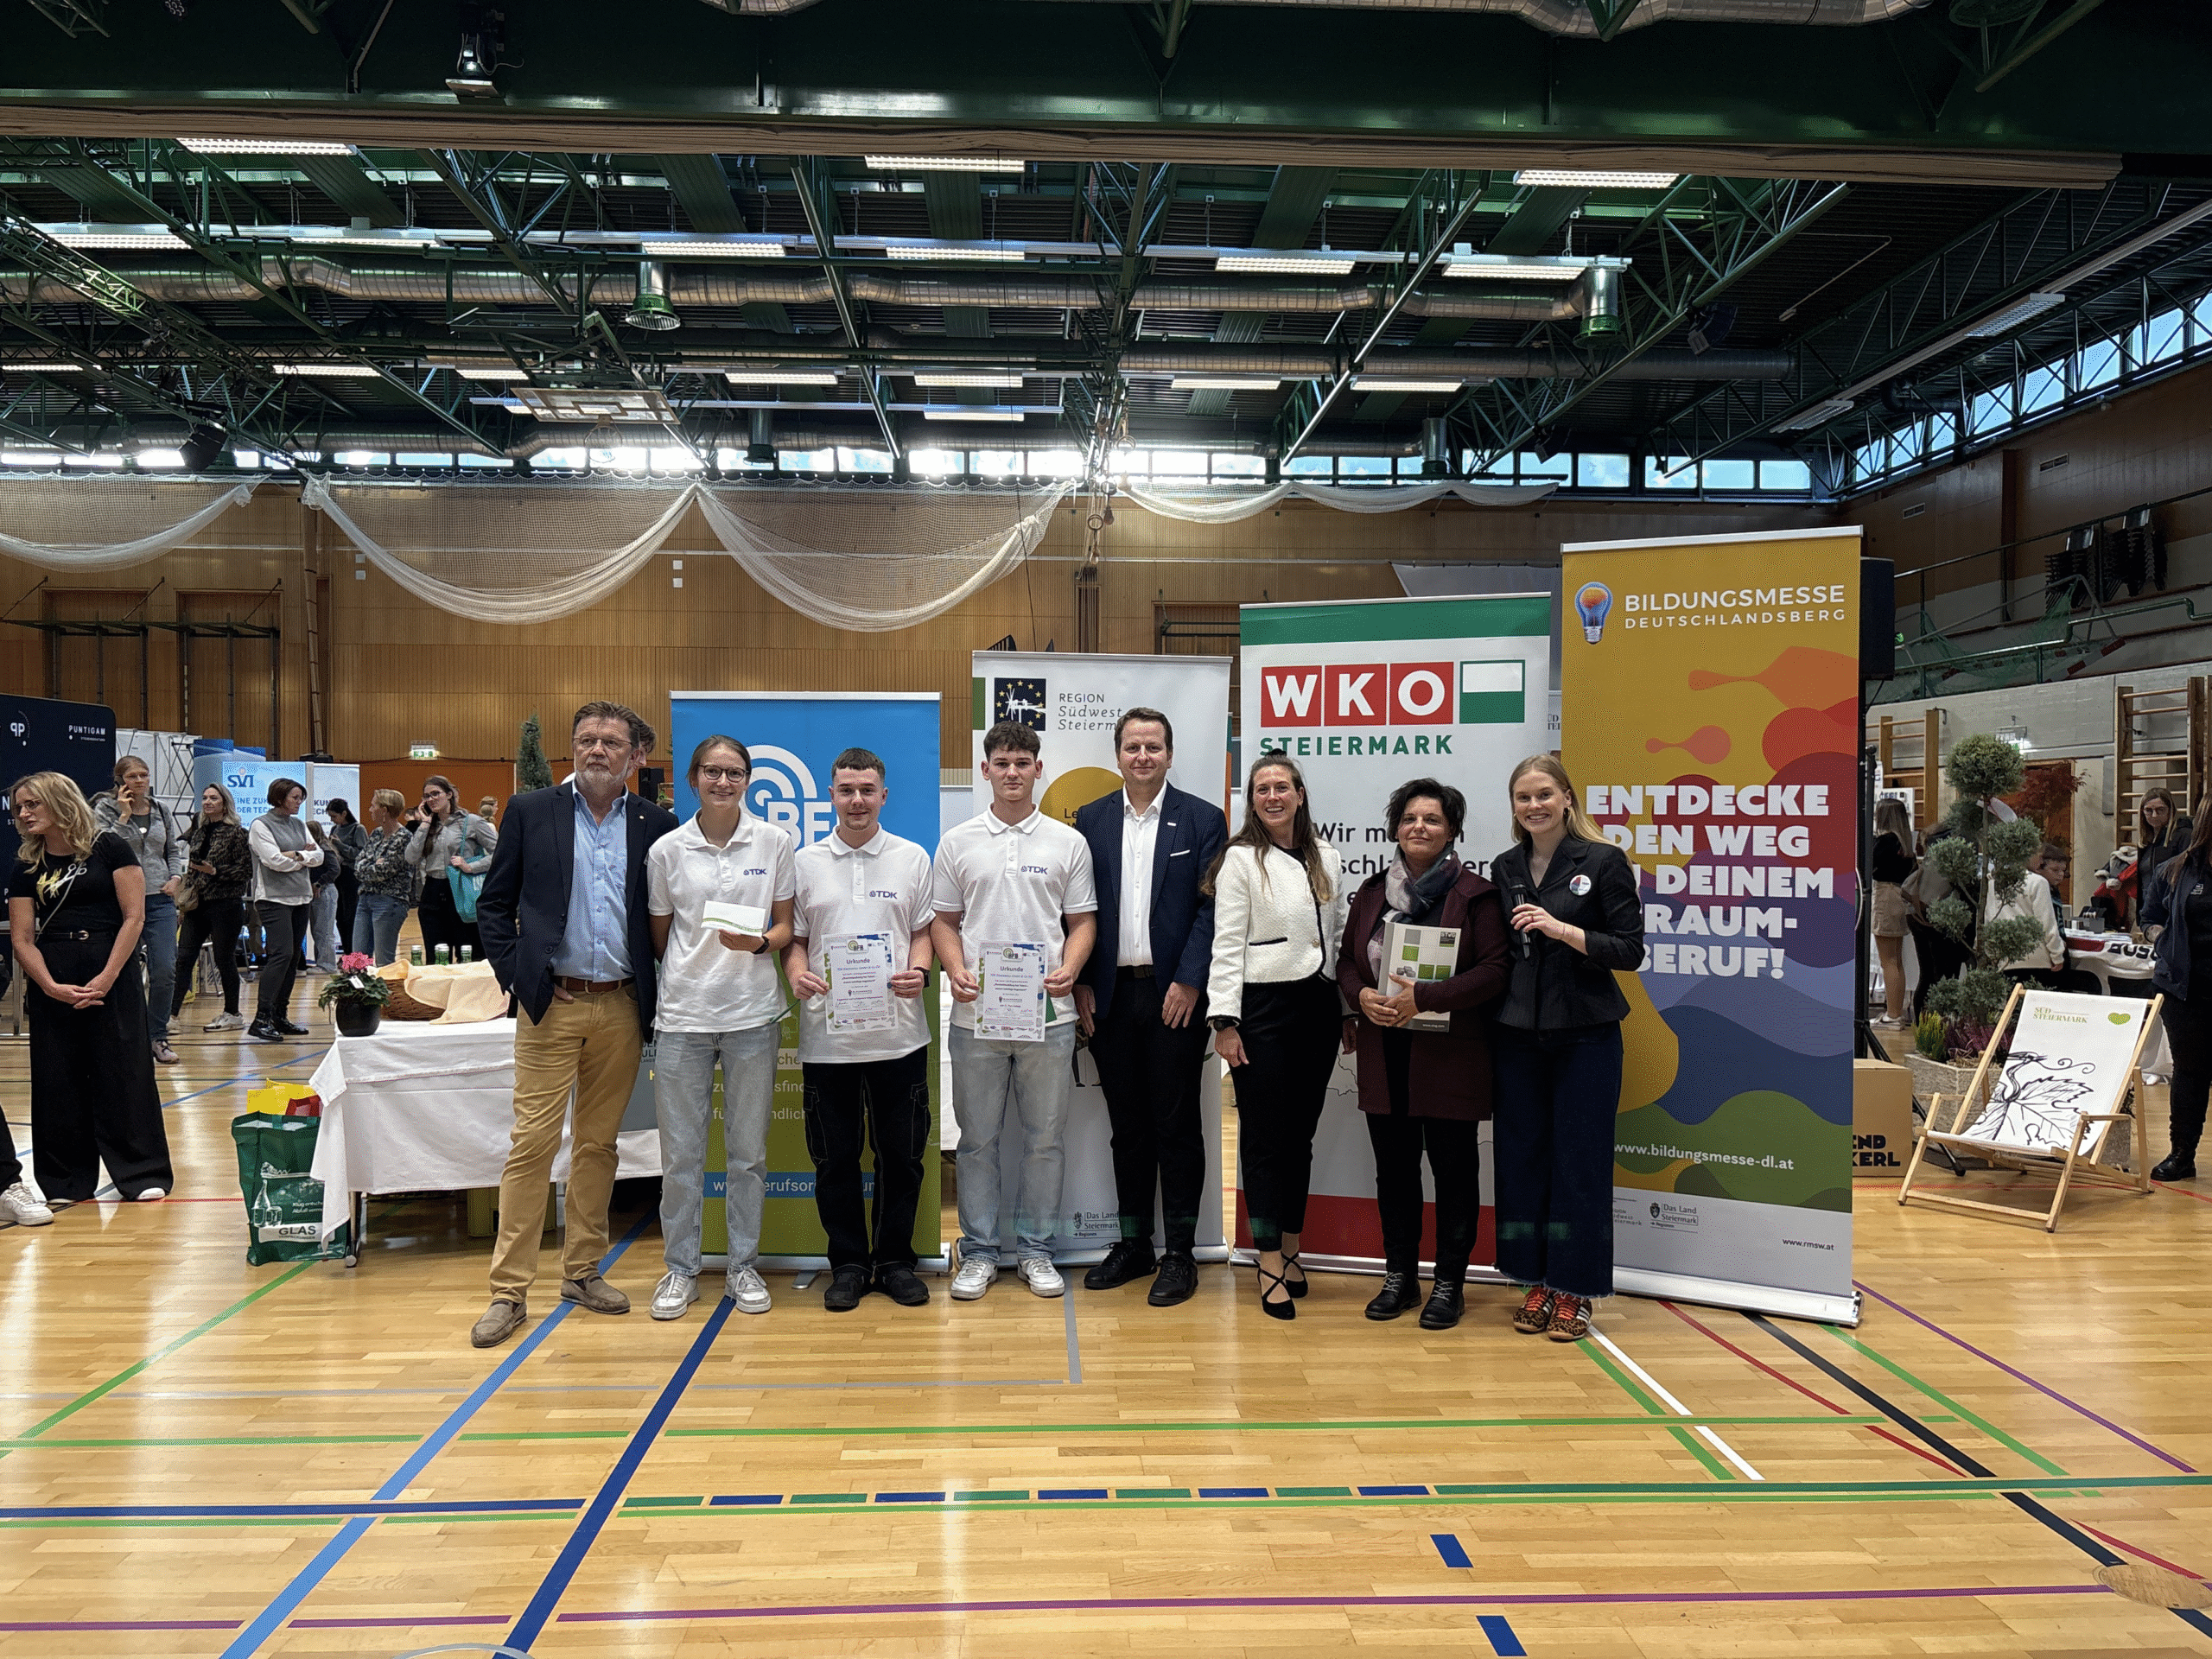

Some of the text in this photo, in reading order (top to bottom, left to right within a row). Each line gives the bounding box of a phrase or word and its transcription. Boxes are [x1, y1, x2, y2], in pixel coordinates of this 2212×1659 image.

[1624, 584, 1846, 612] BILDUNGSMESSE
[1624, 608, 1846, 629] DEUTSCHLANDSBERG
[1059, 694, 1104, 703] REGION
[1265, 670, 1446, 718] WKO
[68, 725, 106, 735] PUNTIGAM
[1058, 719, 1116, 731] Steierm
[1260, 734, 1453, 757] STEIERMARK
[227, 775, 255, 787] SVI
[1586, 785, 1828, 817] ENTDECKE
[1314, 823, 1357, 842] Wir
[1602, 824, 1809, 857] DEN WEG
[1027, 865, 1048, 875] TDK
[1656, 864, 1834, 899] DEINEM
[876, 890, 898, 899] TDK
[1638, 904, 1797, 938] RAUM-
[2033, 1014, 2088, 1024] STEIERMARK
[1613, 1142, 1794, 1171] www.bildungsmesse-dl.at
[1086, 1211, 1100, 1220] Das
[1662, 1204, 1697, 1215] Das Land
[1661, 1214, 1697, 1224] Steiermark
[278, 1225, 317, 1236] GLAS
[1084, 1221, 1120, 1230] Steiermark
[1782, 1238, 1835, 1251] www.rmsw.at
